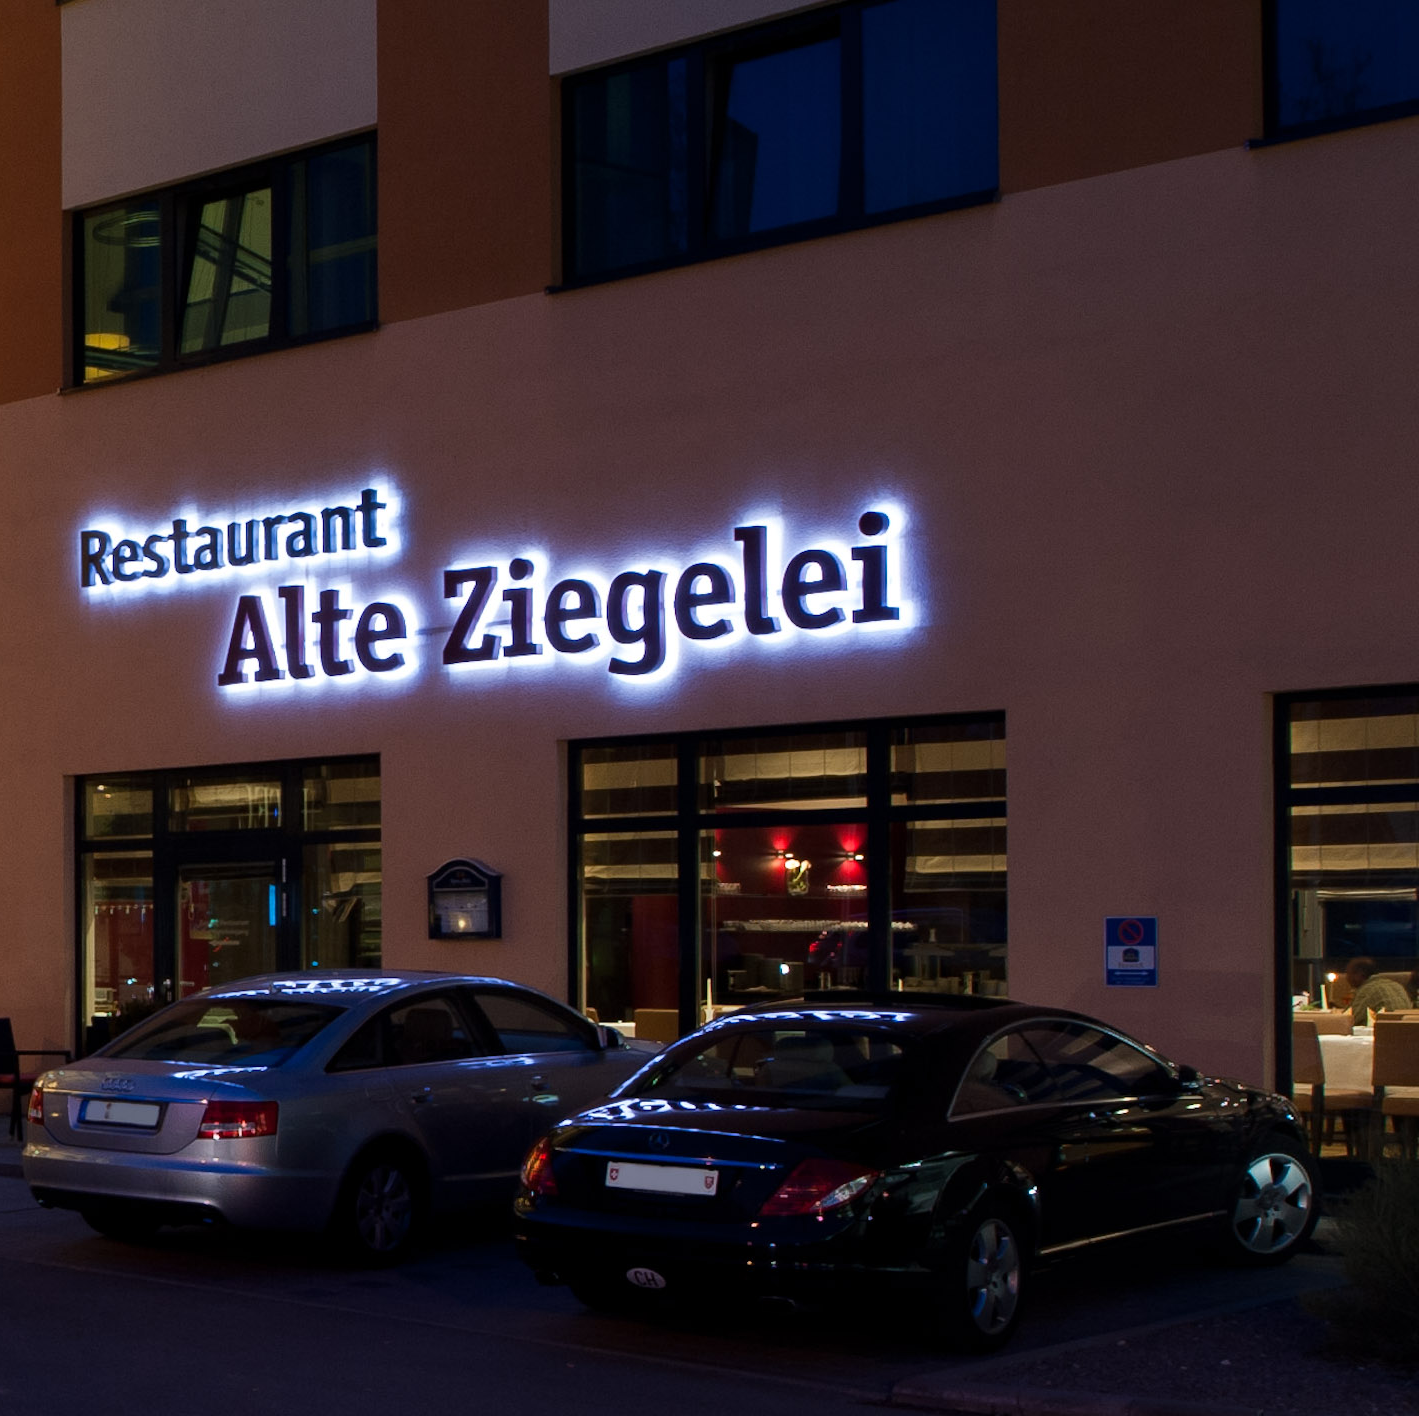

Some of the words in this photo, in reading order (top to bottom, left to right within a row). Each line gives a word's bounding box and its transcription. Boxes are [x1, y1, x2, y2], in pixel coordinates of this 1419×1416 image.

[81, 488, 387, 587] Restaurant
[218, 585, 407, 686] Alte
[442, 511, 901, 676] Ziegelei
[634, 1270, 659, 1287] CH
